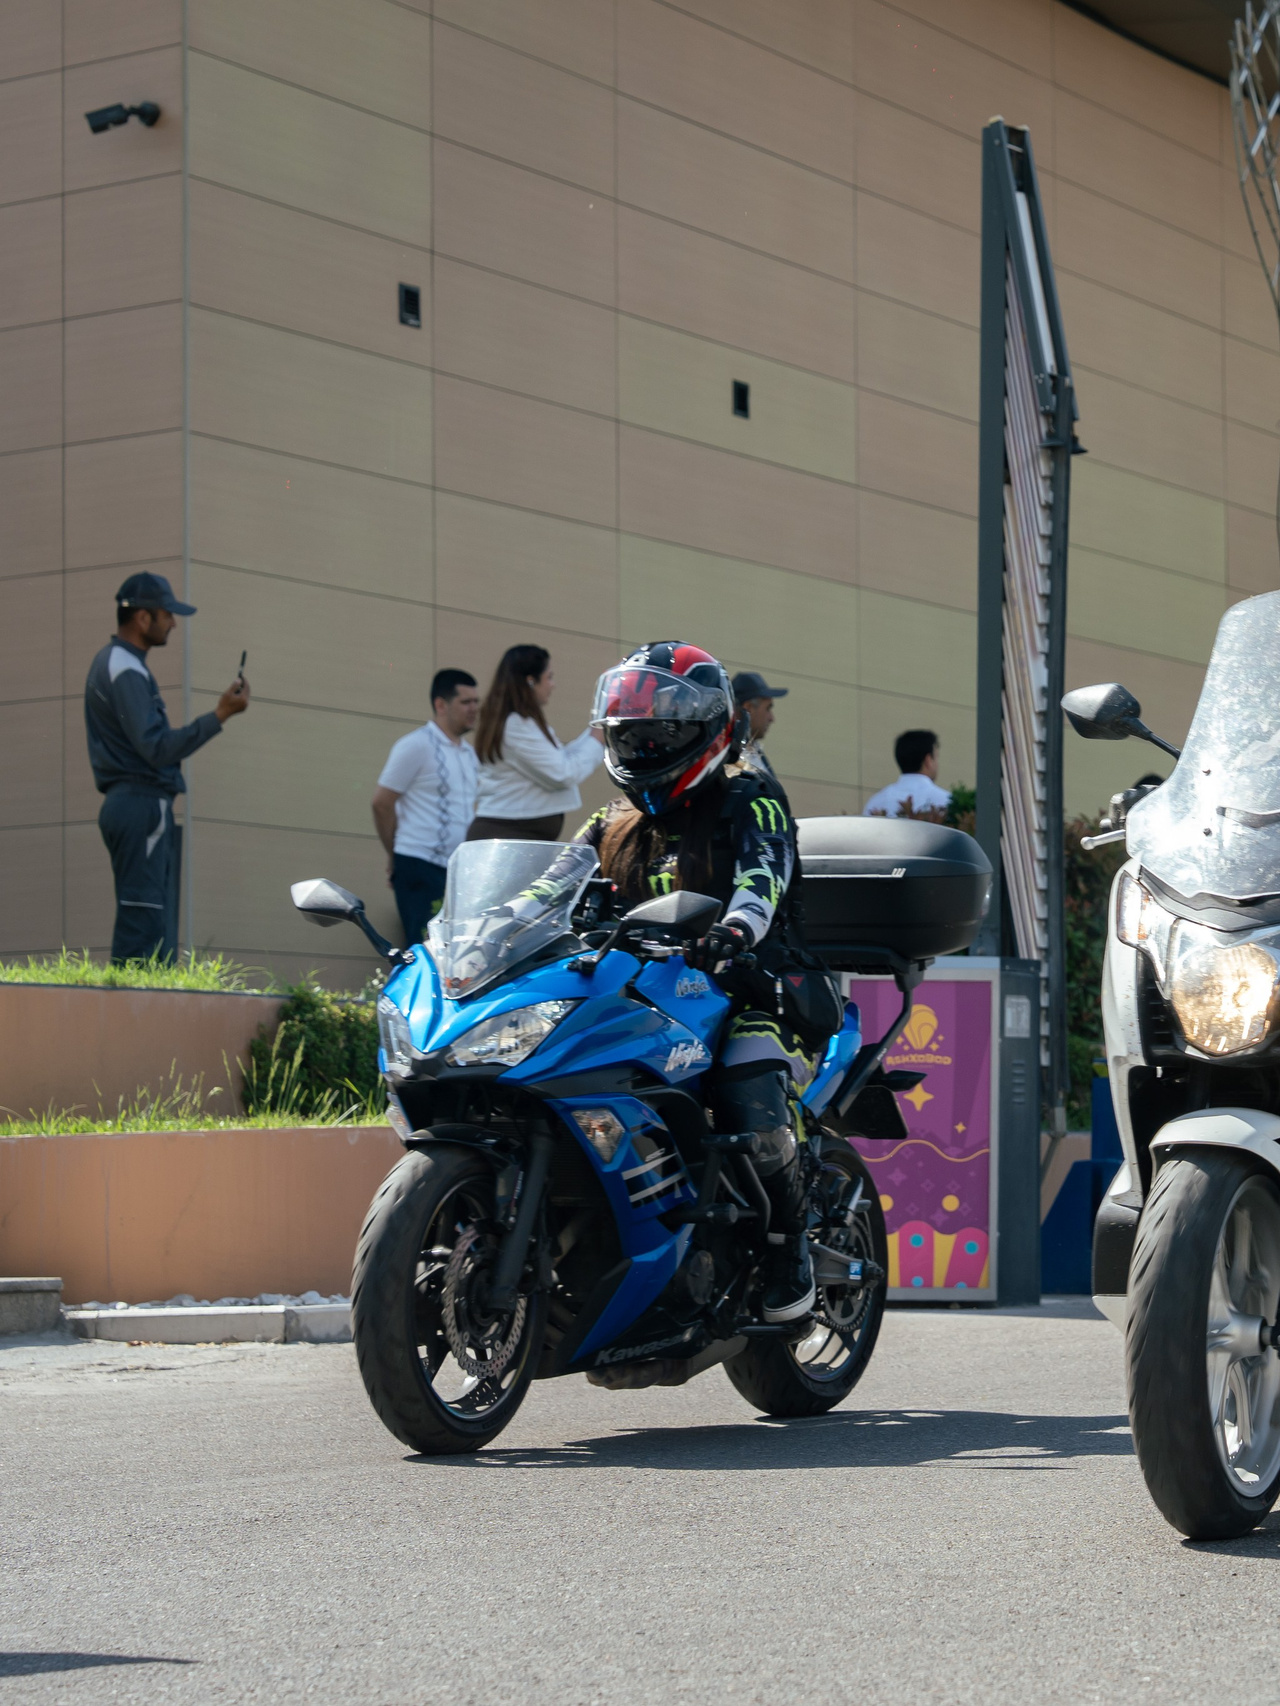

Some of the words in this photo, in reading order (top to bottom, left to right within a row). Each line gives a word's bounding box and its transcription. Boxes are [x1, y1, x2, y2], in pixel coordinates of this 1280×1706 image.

[675, 975, 712, 999] Ninja
[664, 1039, 706, 1073] Ninja
[885, 1053, 953, 1067] ASHXOBOD
